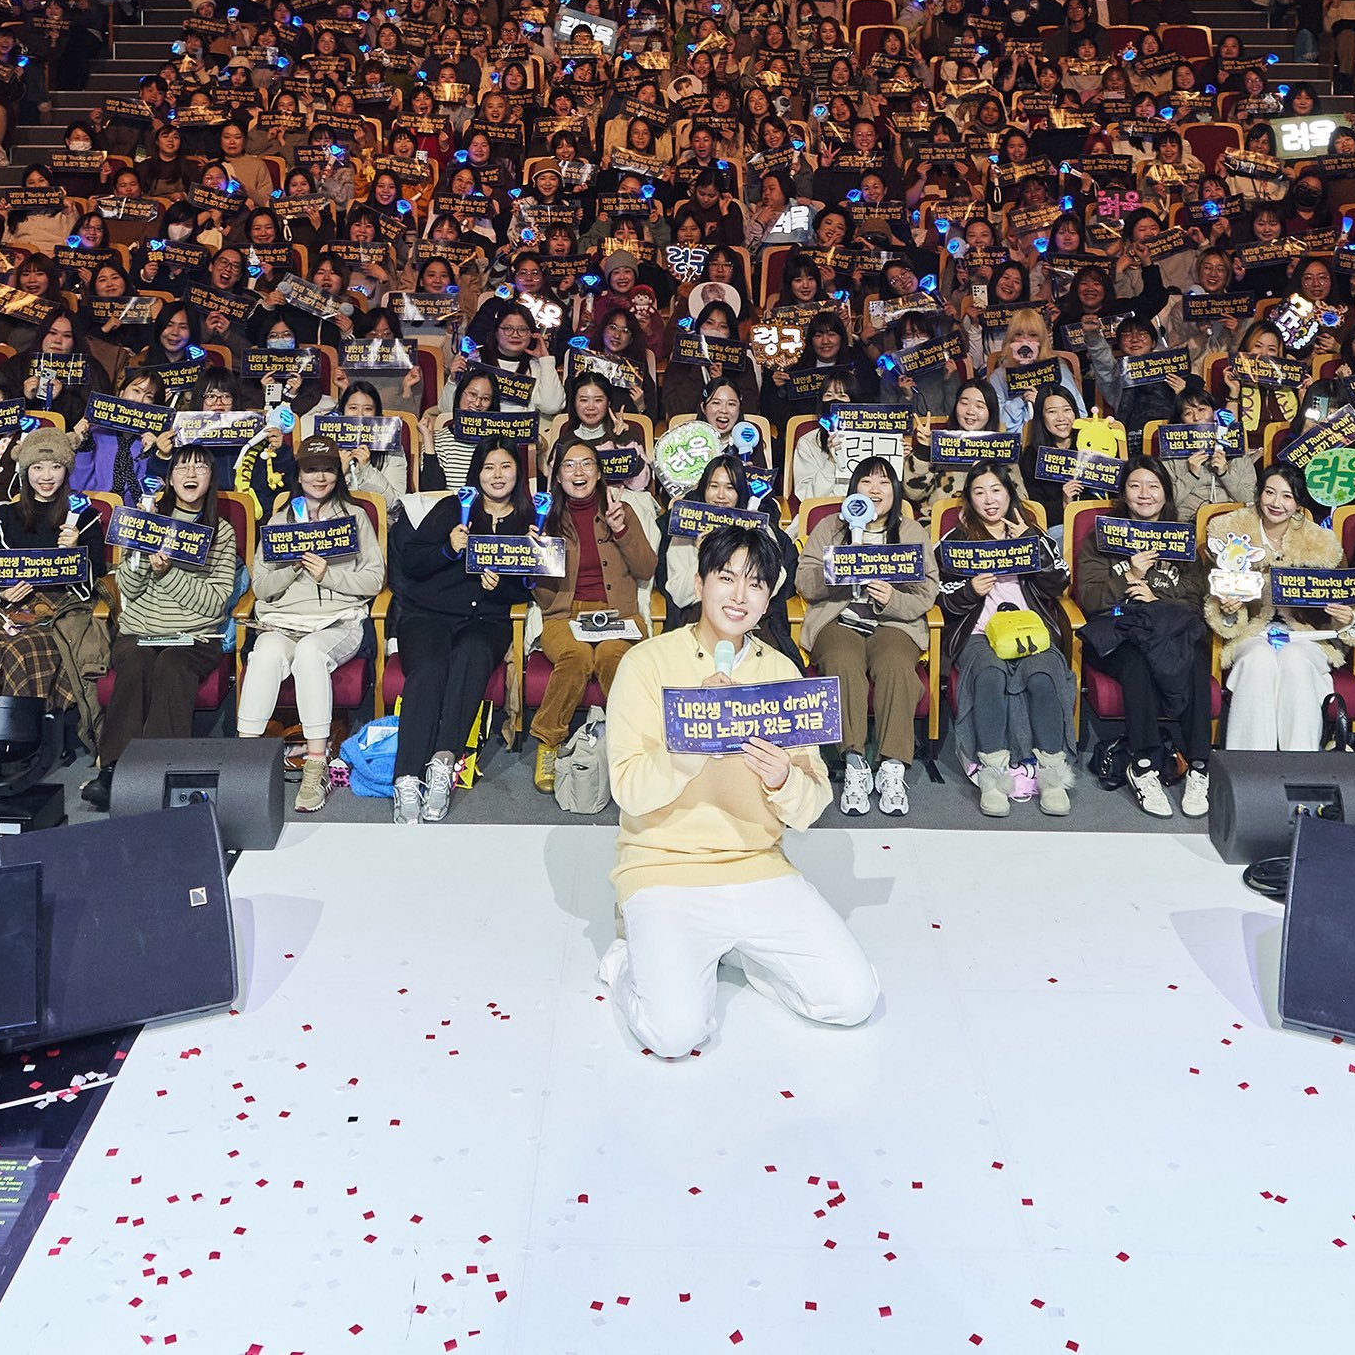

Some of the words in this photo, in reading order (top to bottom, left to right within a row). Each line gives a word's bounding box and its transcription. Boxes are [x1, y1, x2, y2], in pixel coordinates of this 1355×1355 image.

[752, 326, 802, 355] 령구
[94, 400, 115, 413] 내인생
[116, 404, 143, 420] "Rucky
[95, 411, 109, 421] 너의
[110, 414, 131, 426] 노래가
[132, 418, 146, 429] 있는
[148, 421, 162, 432] 지금
[119, 515, 143, 529] 내인생
[145, 520, 176, 537] "Rucky
[1104, 524, 1128, 536] 내인생
[1130, 526, 1162, 539] "Rucky
[119, 528, 135, 540] 너의
[136, 532, 162, 546] 노래가
[163, 538, 180, 551] 있는
[182, 542, 198, 555] 지금
[1107, 537, 1123, 547] 너의
[1125, 538, 1150, 549] 노래가
[1151, 540, 1167, 551] 있는
[1169, 541, 1186, 552] 지금
[22, 555, 53, 567] "Rucky
[832, 554, 856, 564] 내인생
[858, 552, 889, 564] "Rucky
[16, 567, 41, 578] 노래가
[42, 566, 59, 577] 있는
[61, 566, 78, 576] 지금
[835, 565, 851, 574] 너의
[853, 565, 878, 574] 노래가
[880, 565, 897, 574] 있는
[899, 565, 915, 574] 지금
[1279, 576, 1305, 585] 내인생
[1307, 576, 1340, 586] "Rucky
[1282, 588, 1299, 597] 너의
[1301, 587, 1328, 597] 노래가
[1330, 587, 1347, 597] 있는
[678, 700, 721, 720] 내인생
[725, 698, 780, 718] "Rucky
[684, 722, 713, 739] 너의
[716, 718, 760, 738] 노래가
[763, 717, 792, 735] 있는
[795, 712, 824, 731] 지금
